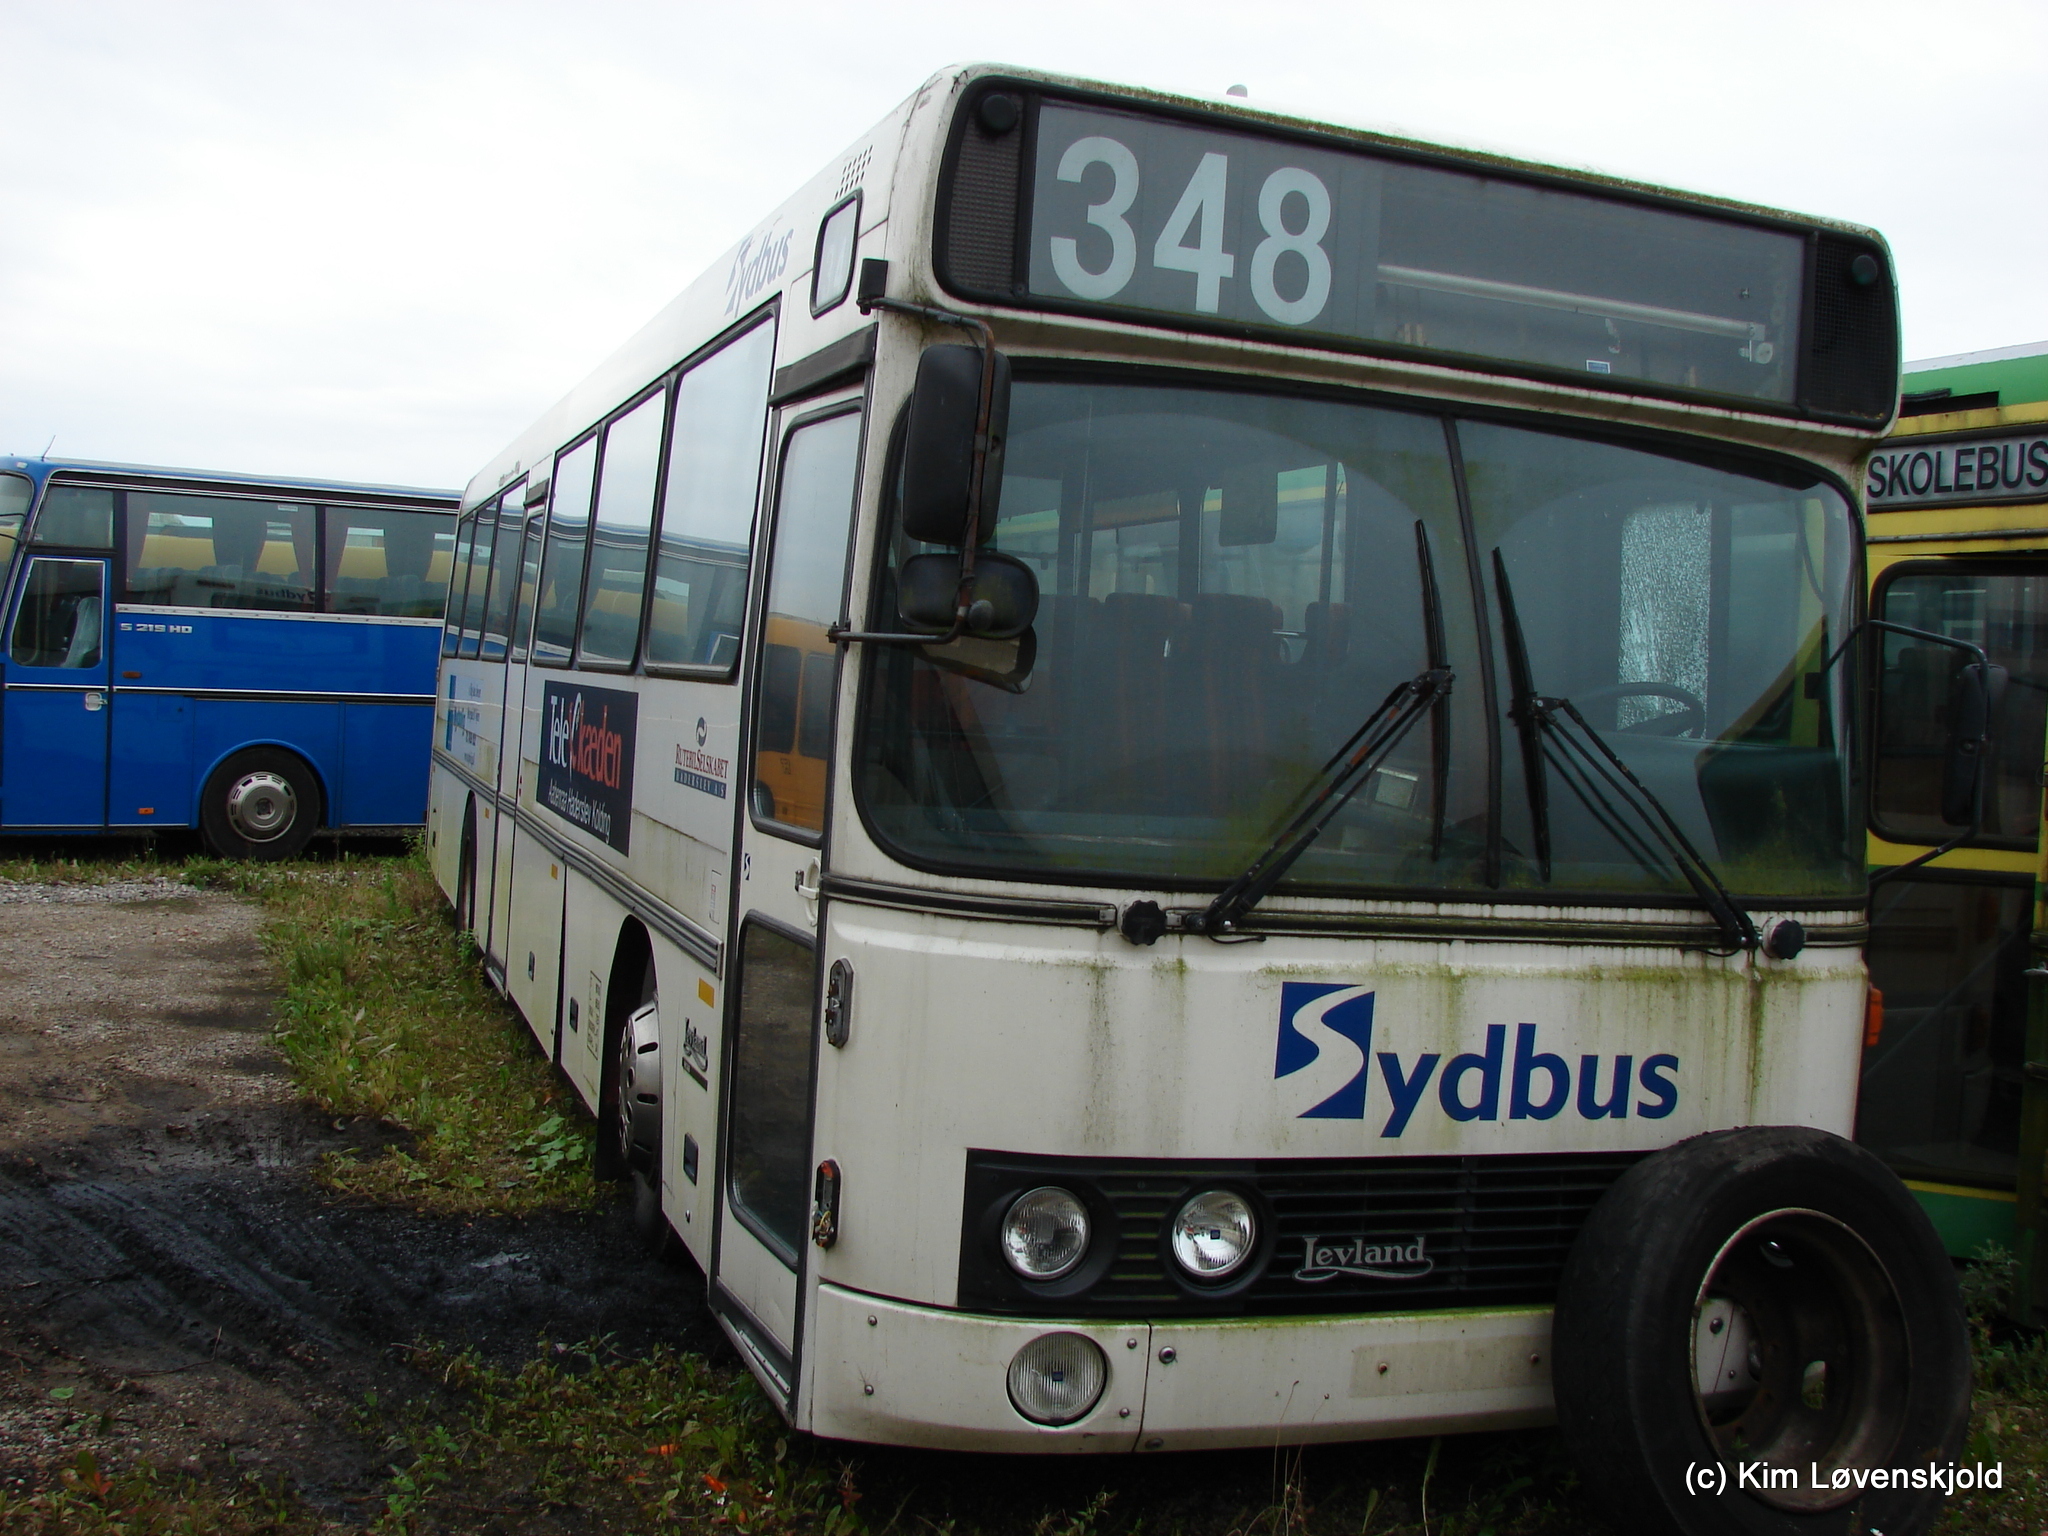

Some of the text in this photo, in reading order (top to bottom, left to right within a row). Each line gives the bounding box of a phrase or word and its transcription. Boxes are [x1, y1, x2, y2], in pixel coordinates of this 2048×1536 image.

[1051, 137, 1331, 325] 348
[1867, 441, 2048, 498] SKOLEBUS
[120, 623, 133, 631] S
[136, 623, 166, 632] 215
[566, 788, 592, 825] Haderslev
[592, 799, 611, 844] Kolding
[1274, 981, 1680, 1138] Sydbus
[1292, 1235, 1435, 1283] Leyland
